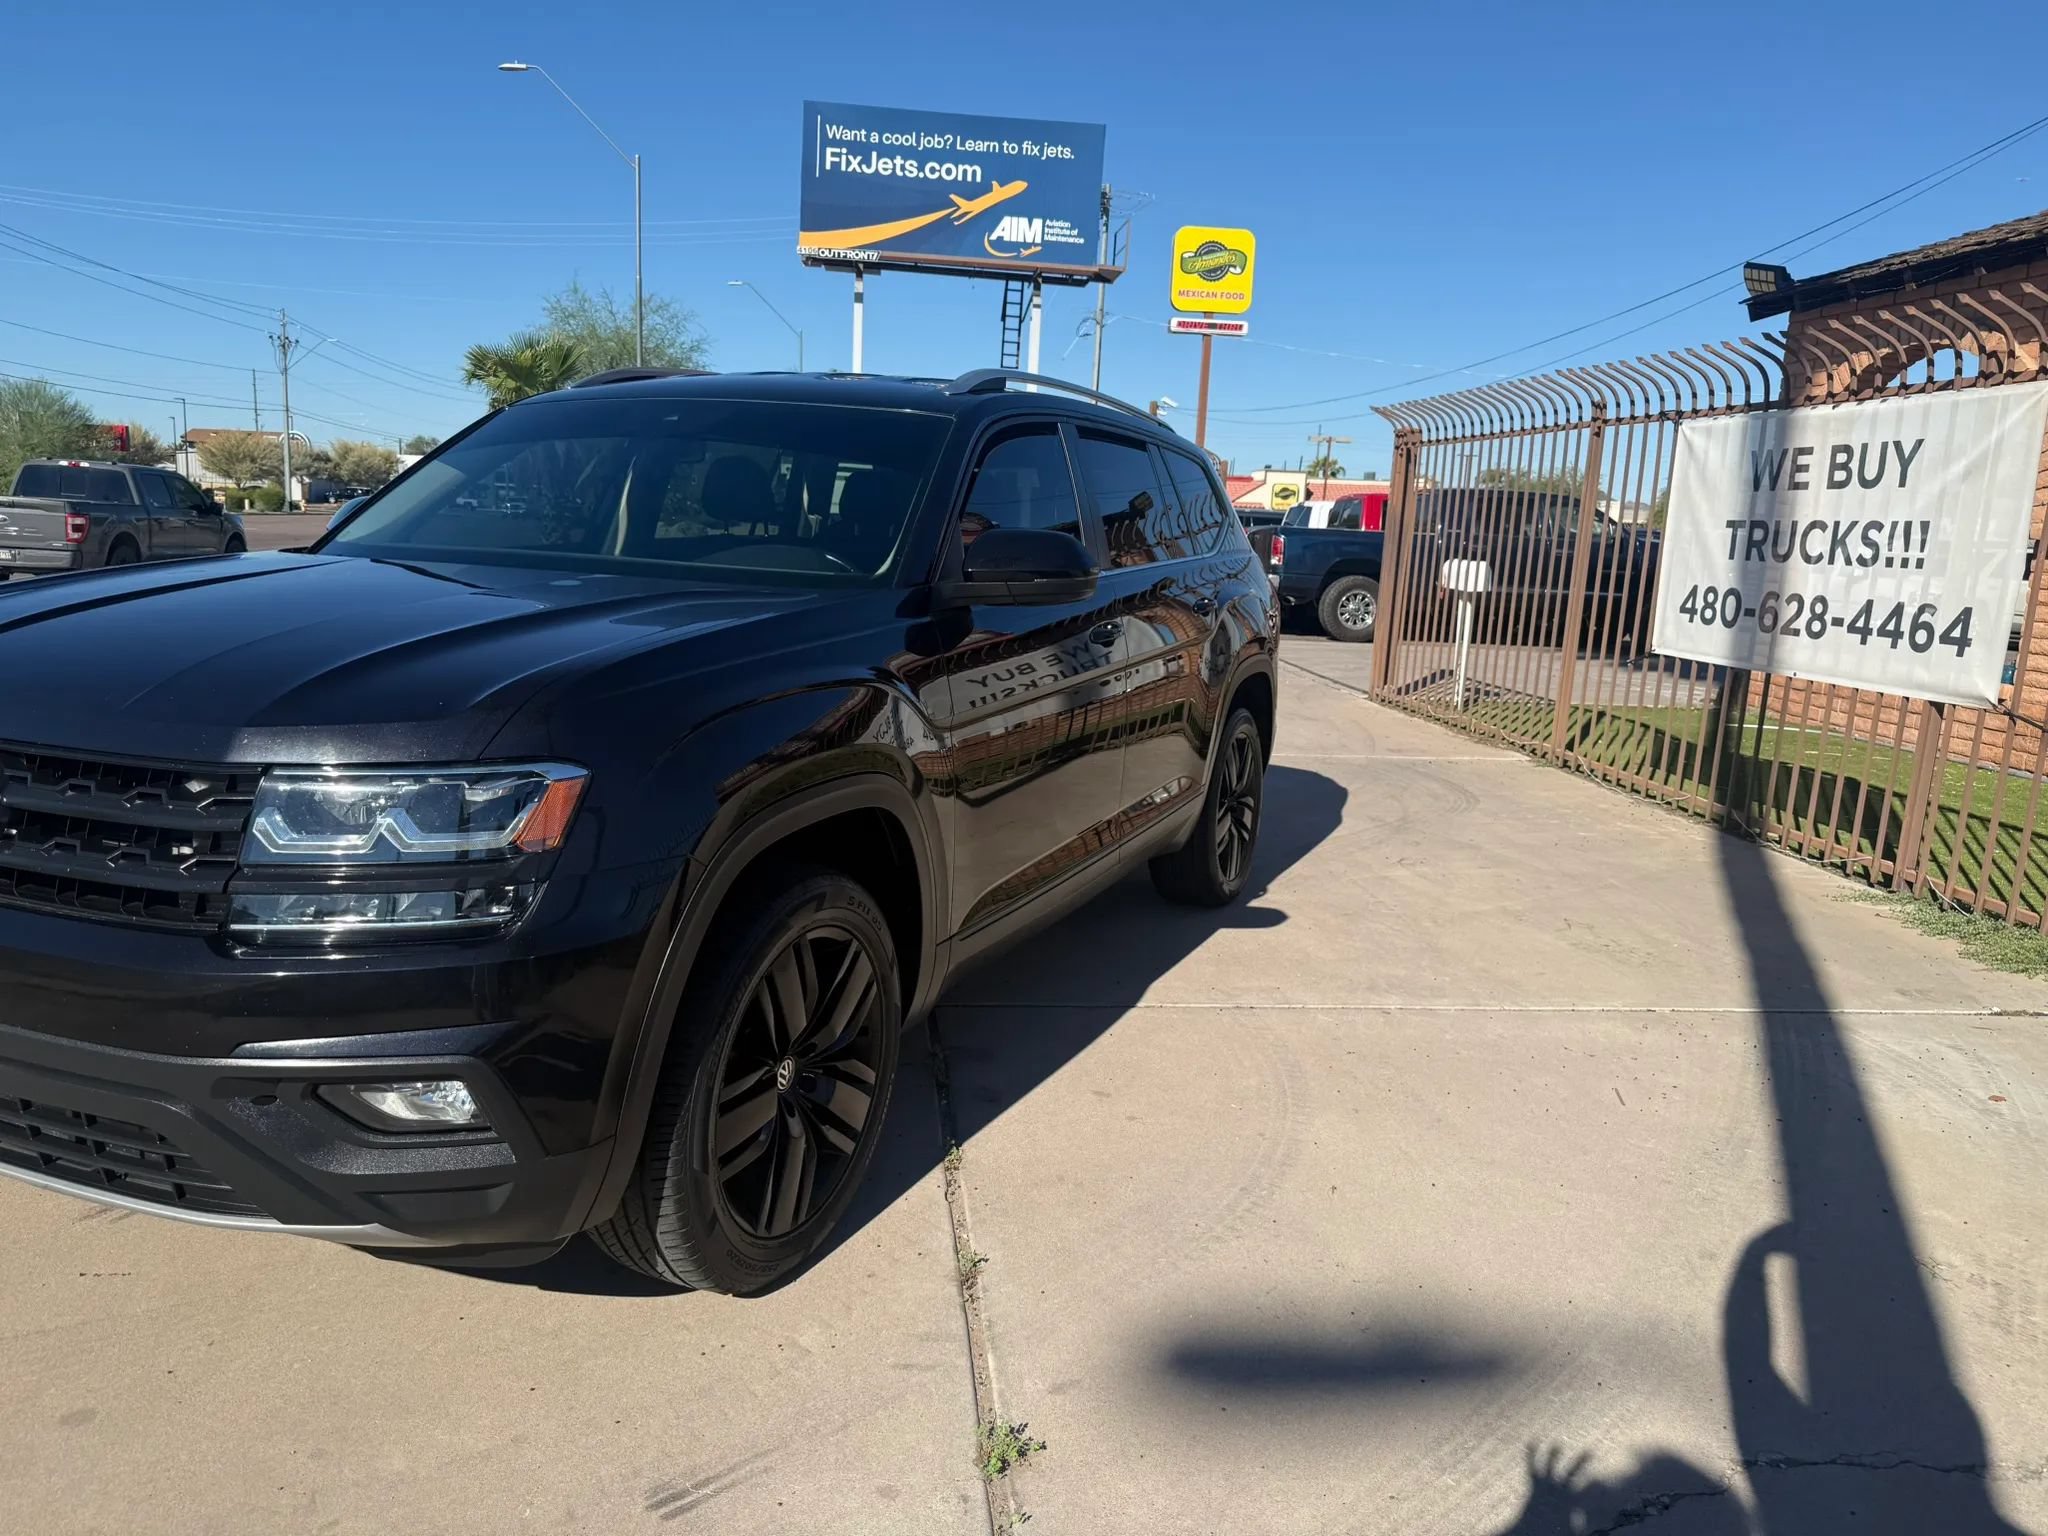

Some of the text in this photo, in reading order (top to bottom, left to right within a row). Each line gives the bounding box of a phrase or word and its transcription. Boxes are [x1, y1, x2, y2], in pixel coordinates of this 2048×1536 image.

[825, 123, 1075, 160] Want a cool job? Learn to fix jets.
[825, 146, 982, 183] FixJets.com
[990, 215, 1043, 244] AIM
[1043, 235, 1085, 244] Maintenance
[1045, 219, 1071, 229] Aviation
[1070, 227, 1079, 236] of
[1178, 289, 1245, 300] MEXICAN FOOD
[1750, 438, 1925, 492] WE BUY
[1725, 519, 1931, 570] TRUCKS!!!
[1679, 584, 1974, 658] 480-628-4464
